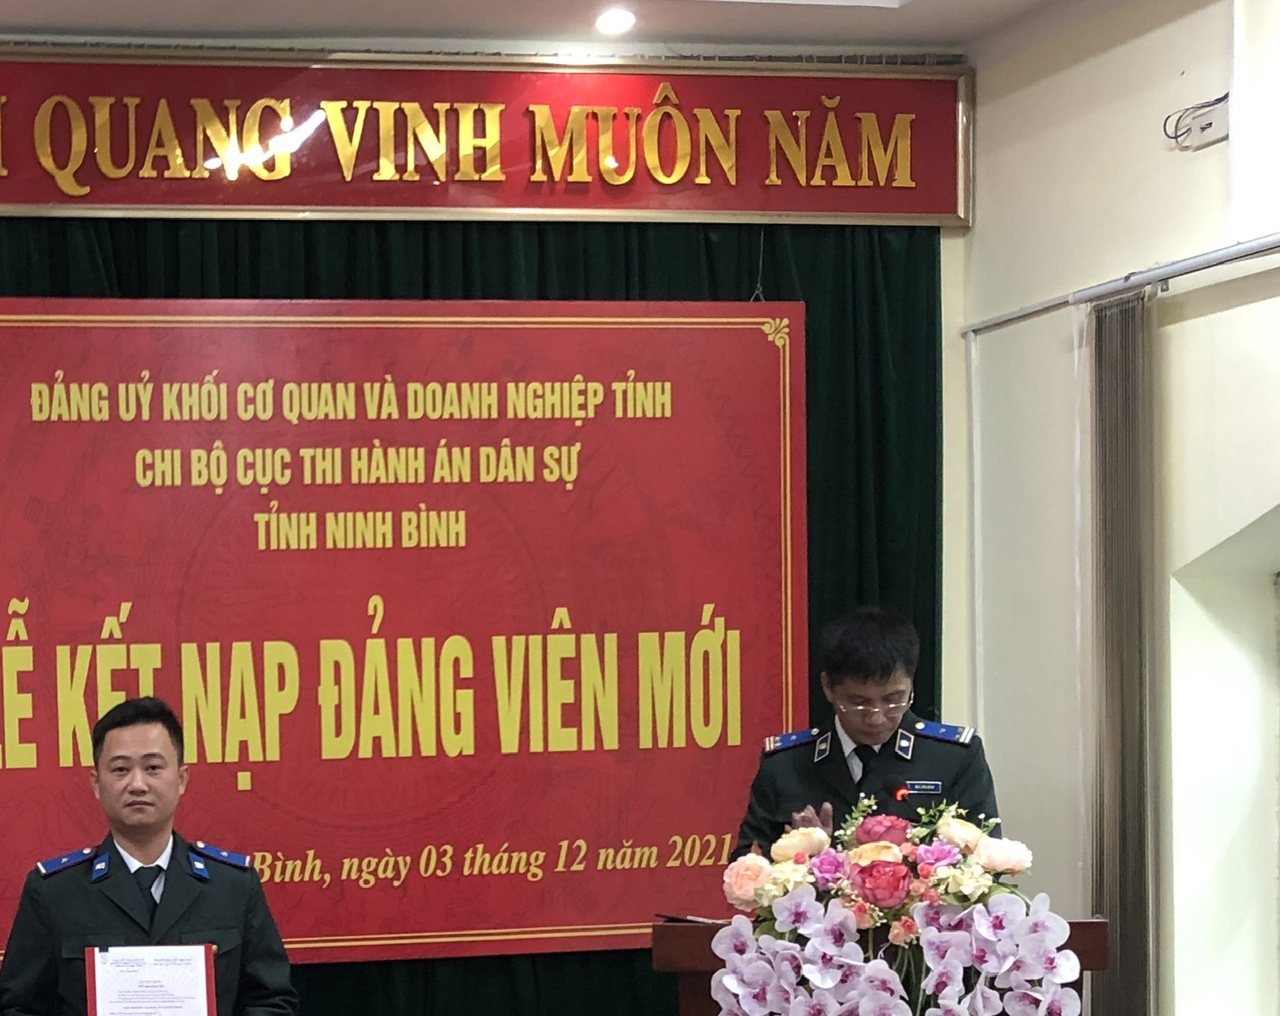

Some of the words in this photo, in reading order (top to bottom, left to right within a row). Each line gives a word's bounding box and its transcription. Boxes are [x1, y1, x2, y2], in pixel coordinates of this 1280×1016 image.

[33, 94, 293, 196] QUANG
[320, 99, 507, 182] VINH
[527, 82, 744, 186] MUÔN
[763, 94, 918, 189] NĂM
[30, 369, 110, 422] ĐẢNG
[118, 369, 154, 422] UỶ
[162, 369, 228, 422] KHỐI
[236, 379, 275, 422] CƠ
[282, 382, 357, 425] QUAN
[363, 374, 400, 420] VÀ
[407, 382, 499, 420] DOANH
[506, 374, 605, 427] NGHIỆP
[611, 369, 672, 419] TỈNH
[135, 448, 182, 487] CHI
[190, 439, 228, 495] BỘ
[236, 448, 292, 495] CỤC
[299, 447, 342, 485] THI
[350, 438, 426, 485] HÀNH
[432, 438, 471, 483] ÁN
[478, 437, 535, 483] DÂN
[542, 442, 582, 491] SỰ
[253, 500, 317, 550] TỈNH
[325, 511, 393, 549] NINH
[401, 503, 467, 548] BÌNH
[55, 601, 162, 768] KẾT
[181, 640, 300, 791] NẠP
[317, 594, 475, 760] ĐẢNG
[491, 606, 619, 755] VIÊN
[638, 603, 741, 750] MỚI
[253, 849, 331, 889] Bình,
[340, 847, 412, 889] ngày
[419, 844, 454, 877] 03
[462, 842, 546, 882] tháng
[553, 838, 588, 872] 12
[596, 838, 658, 871] năm
[665, 833, 733, 868] 2021
